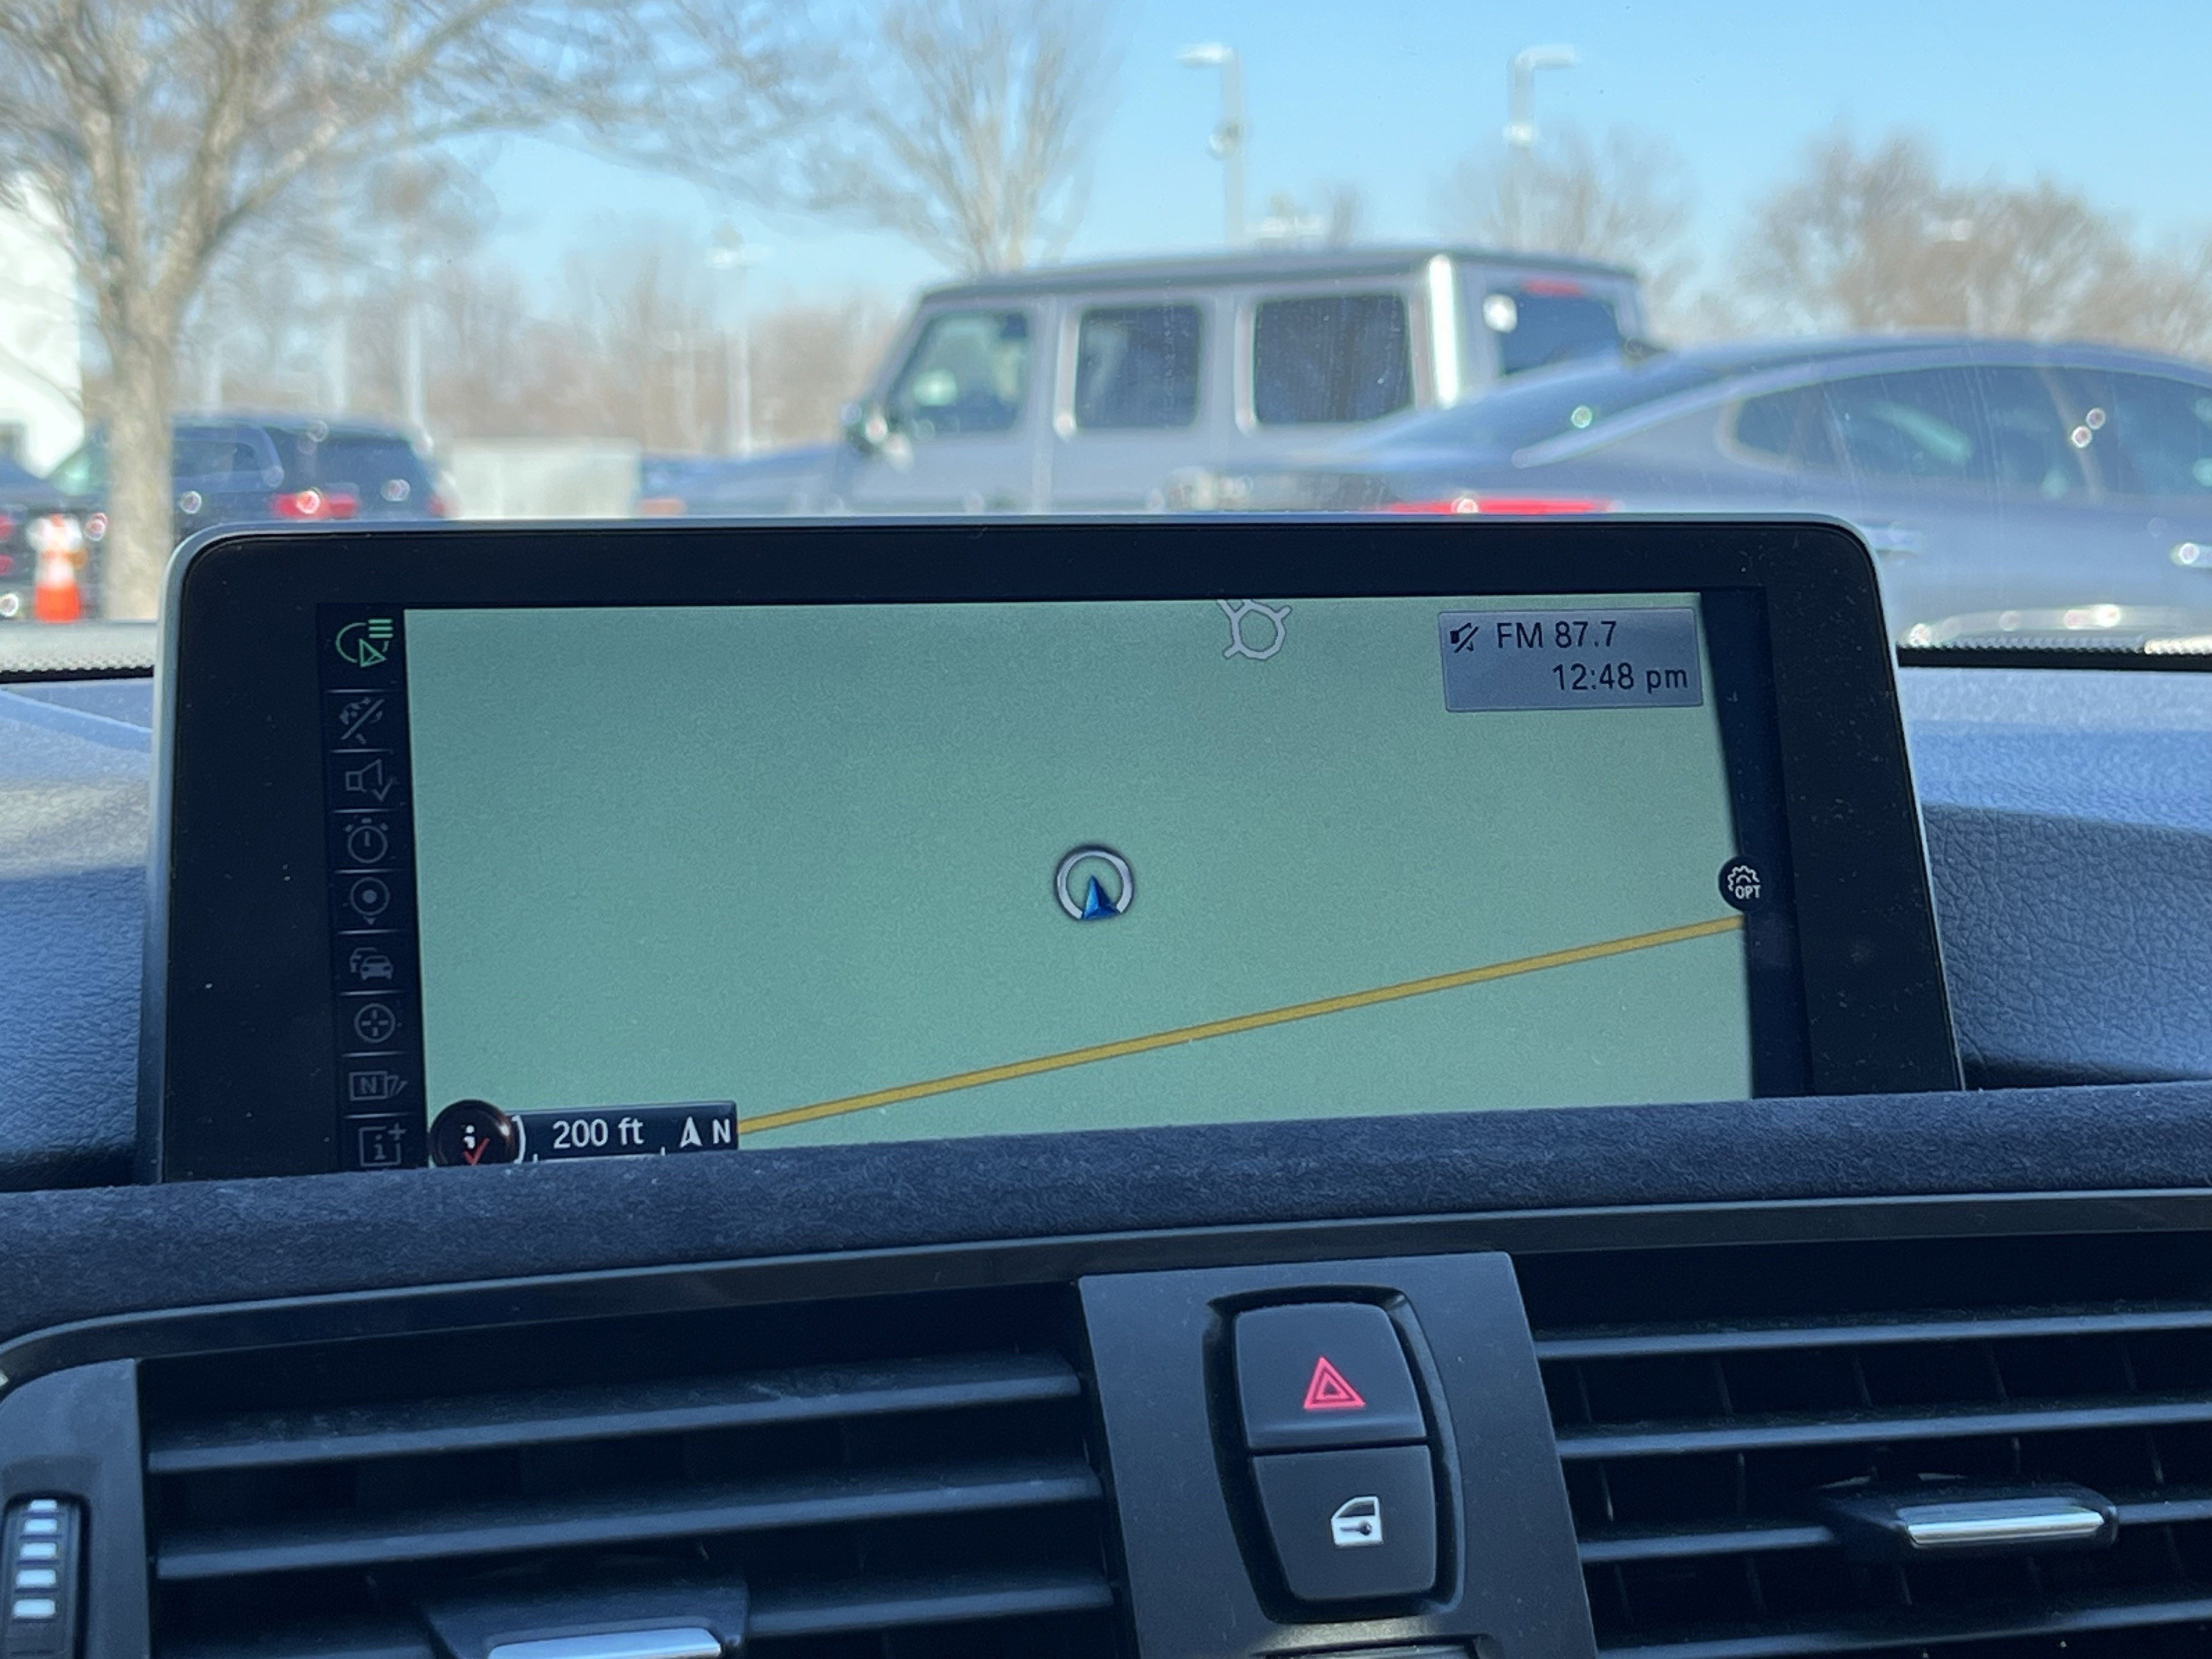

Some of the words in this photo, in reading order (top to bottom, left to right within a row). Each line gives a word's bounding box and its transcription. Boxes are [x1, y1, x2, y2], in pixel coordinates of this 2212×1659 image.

[1496, 622, 1544, 649] FM
[1555, 620, 1617, 648] 87.7
[1553, 662, 1634, 691] 12:48
[1646, 668, 1688, 694] pm
[1734, 884, 1761, 899] OPT
[552, 1118, 608, 1149] 200
[618, 1117, 644, 1145] ft
